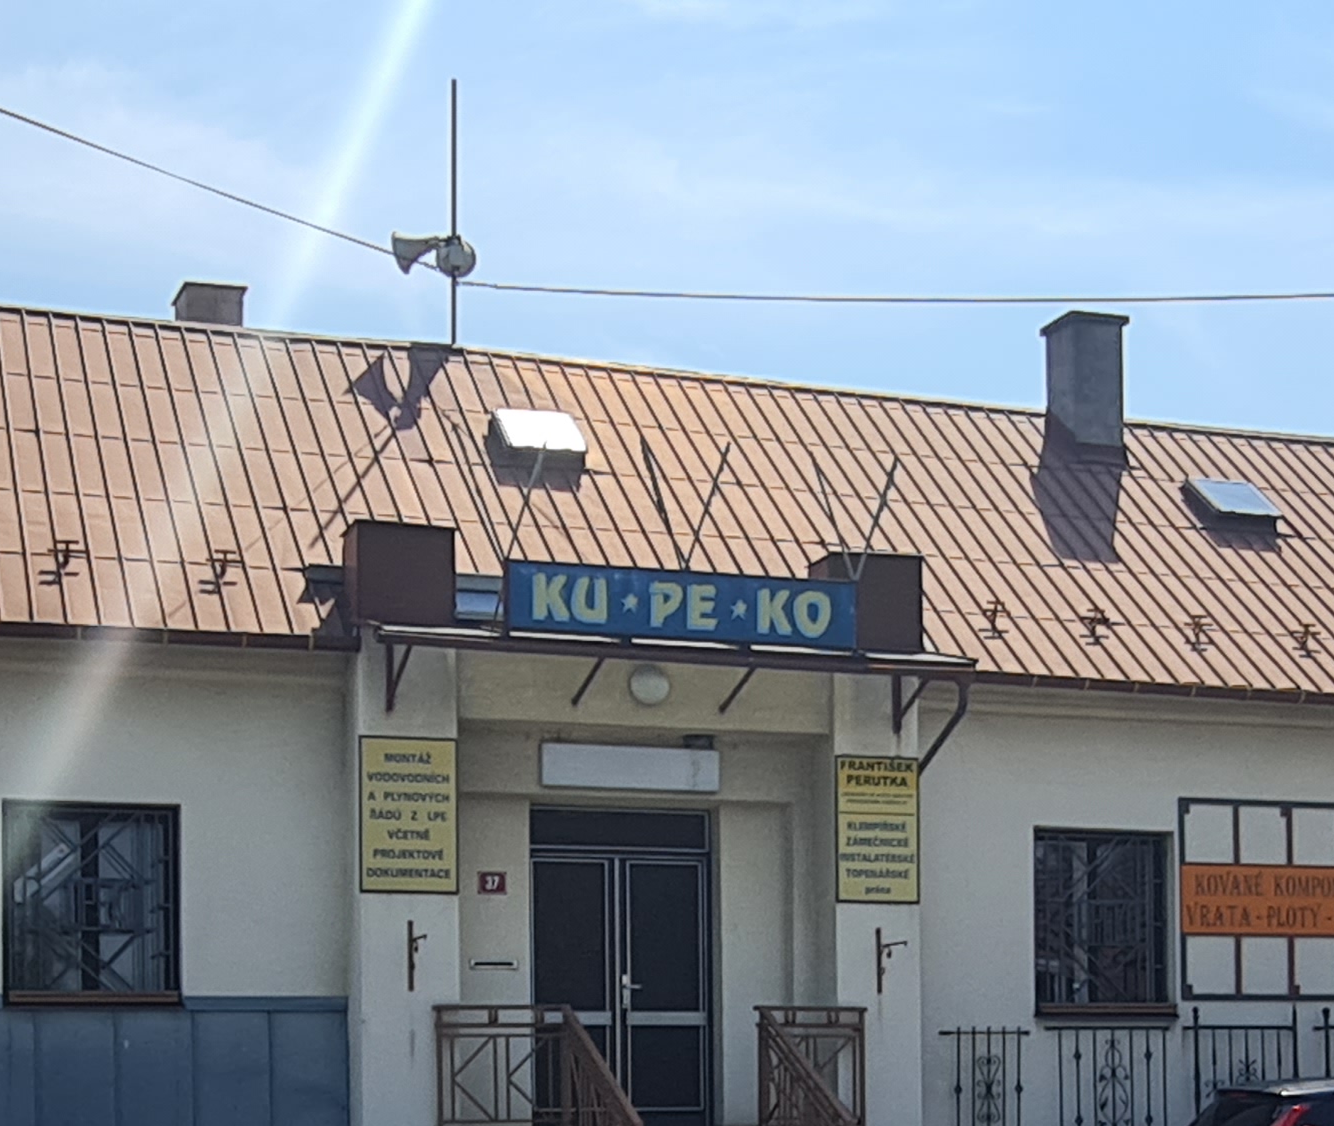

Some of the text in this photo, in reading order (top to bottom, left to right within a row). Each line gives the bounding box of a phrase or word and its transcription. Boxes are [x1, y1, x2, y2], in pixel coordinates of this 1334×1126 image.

[532, 572, 832, 639] KU PE KO
[384, 751, 432, 765] MONTÁŽ
[846, 774, 909, 788] PERUTKA
[368, 791, 376, 802] A
[411, 810, 418, 822] Z
[373, 848, 443, 861] PROJEKTOVÉ
[367, 867, 451, 879] DOKUMENTACE
[485, 875, 499, 890] 37
[1186, 902, 1251, 927] VRATA
[1267, 904, 1322, 928] PLOTY
